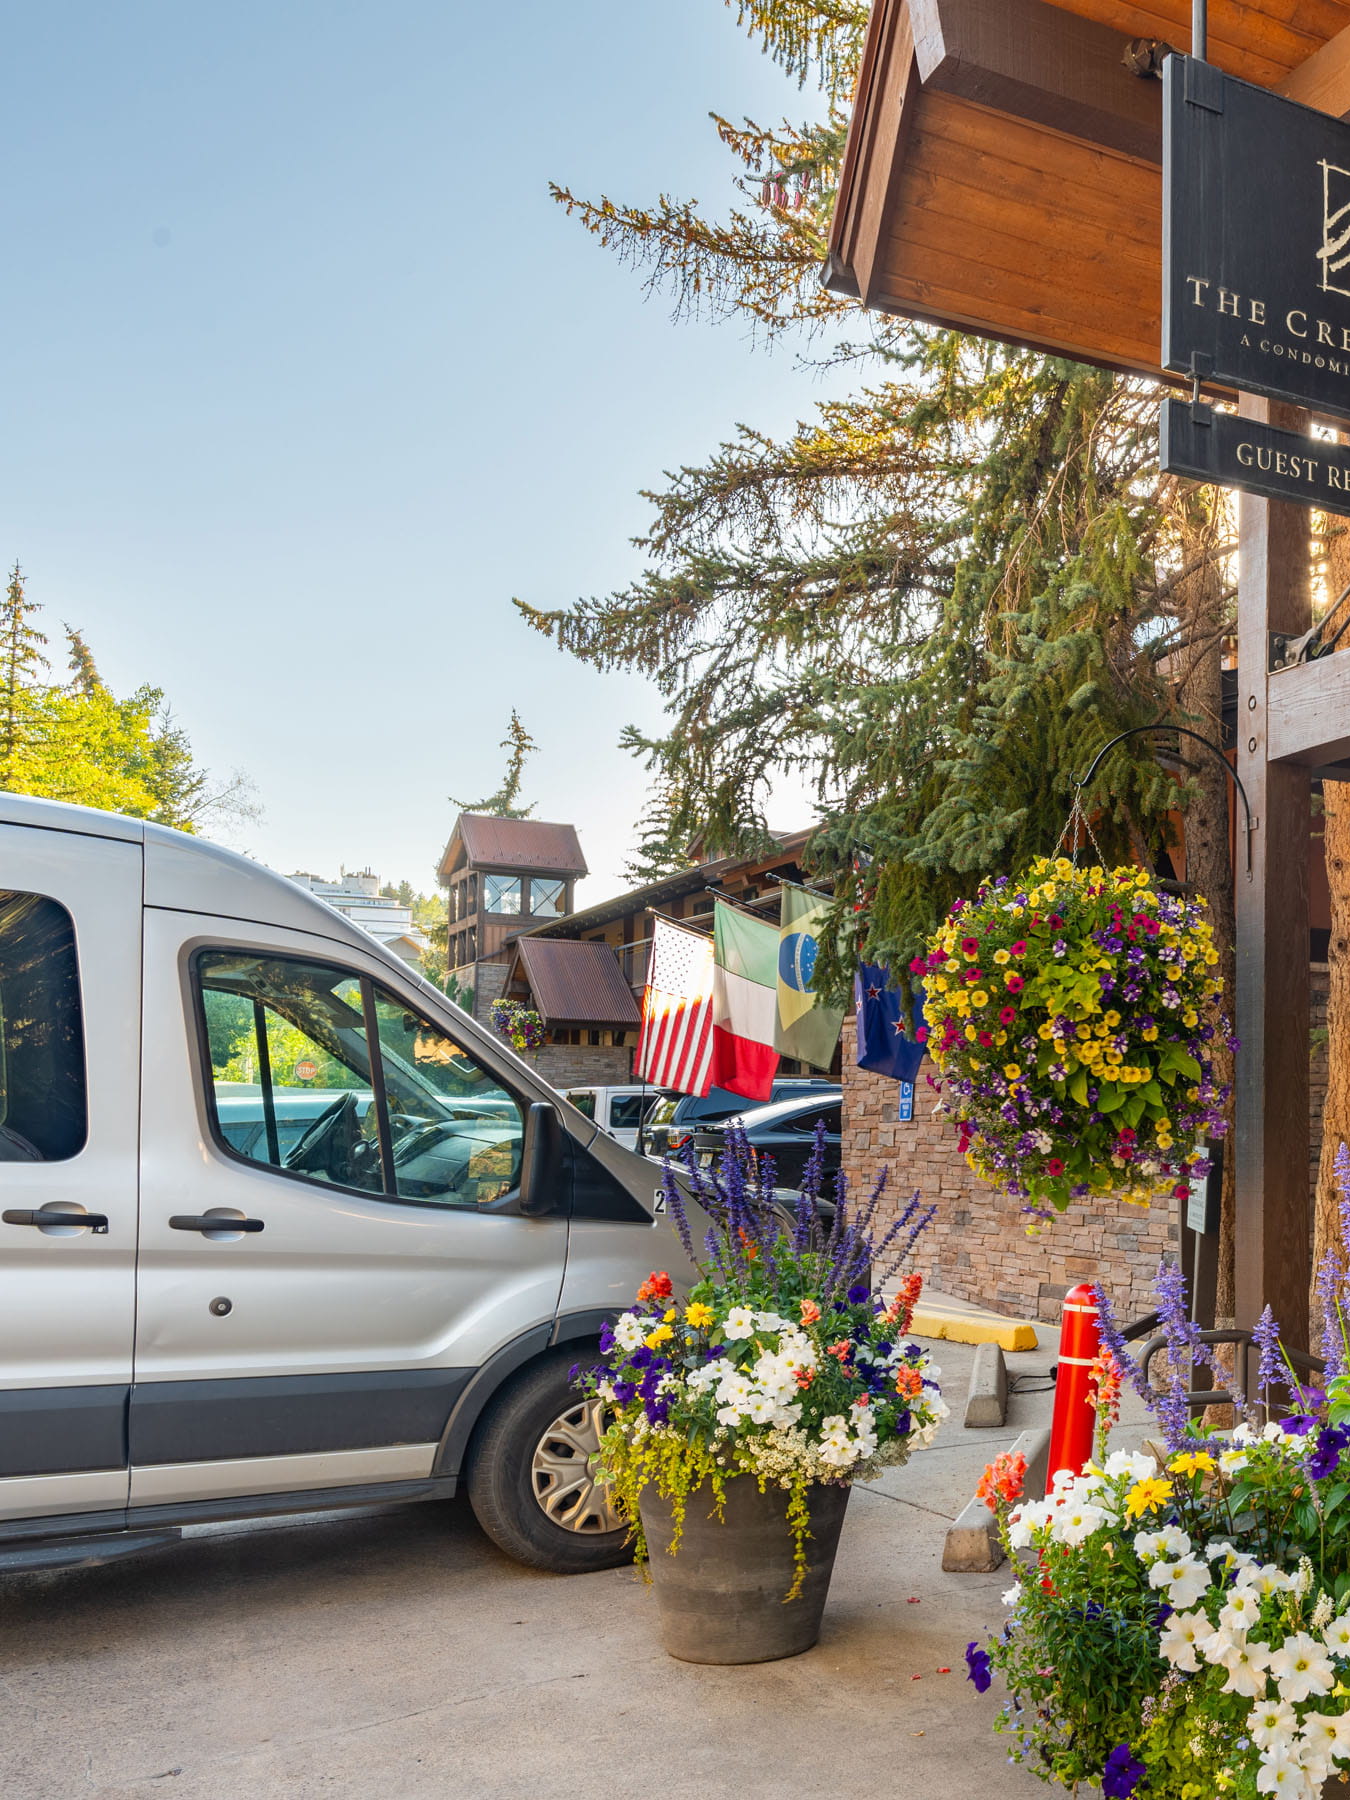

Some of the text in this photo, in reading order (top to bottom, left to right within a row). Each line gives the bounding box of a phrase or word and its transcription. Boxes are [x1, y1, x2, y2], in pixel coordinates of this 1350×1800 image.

[1186, 275, 1265, 325] THE
[1240, 333, 1250, 347] A
[1236, 443, 1318, 482] GUEST
